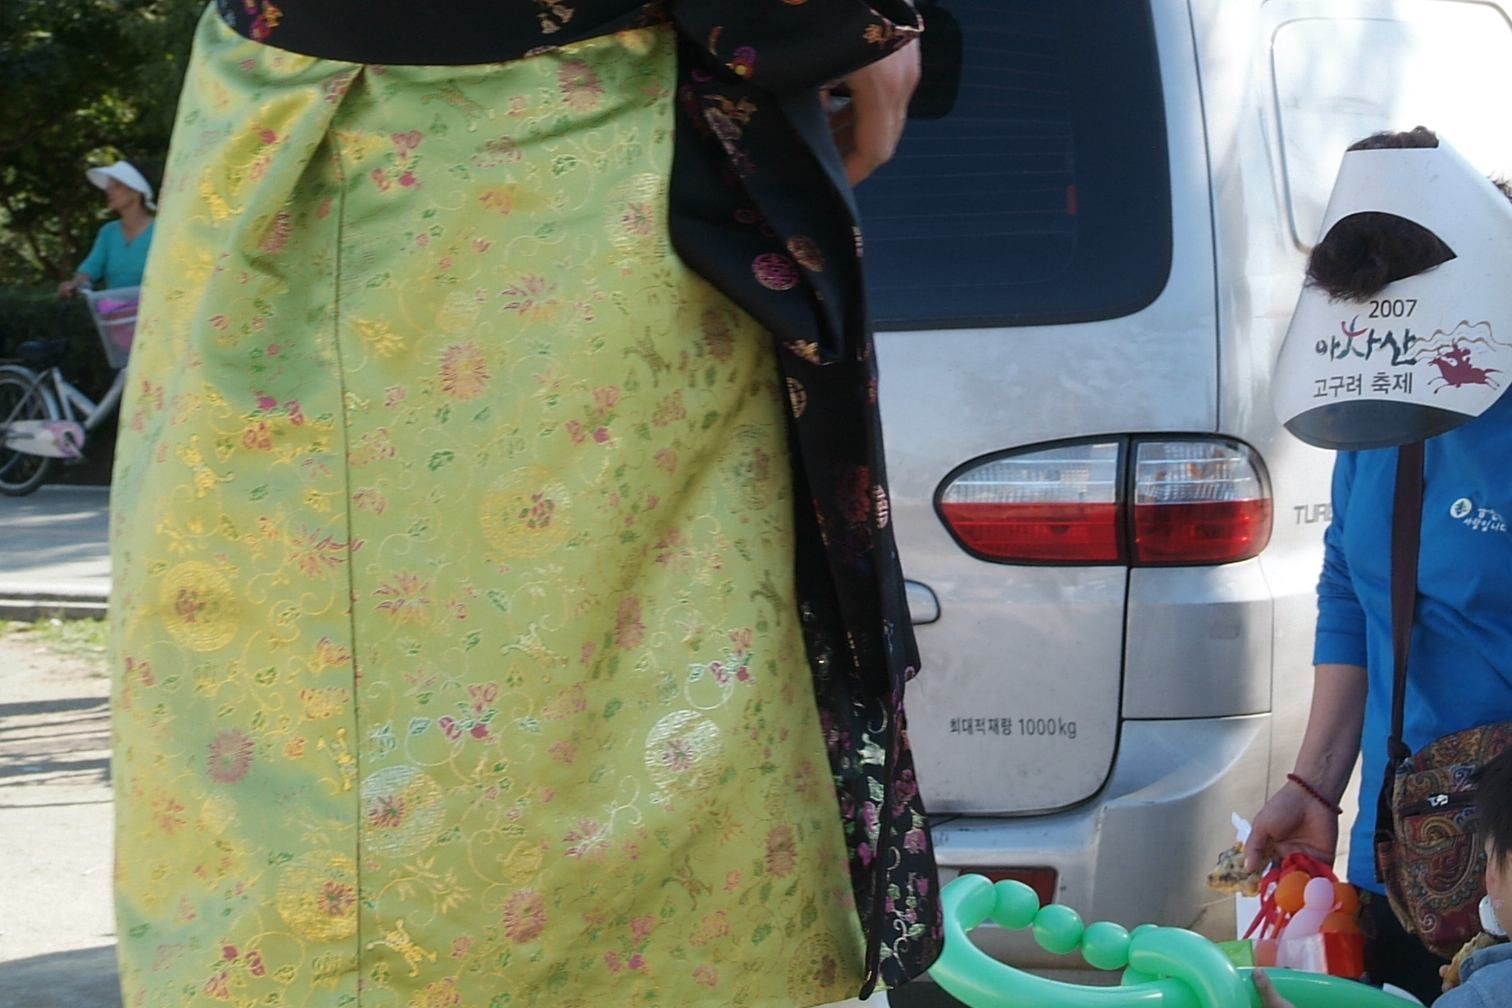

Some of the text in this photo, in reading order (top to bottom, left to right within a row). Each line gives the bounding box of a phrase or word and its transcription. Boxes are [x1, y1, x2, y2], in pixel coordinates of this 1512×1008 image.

[1368, 299, 1418, 319] 2007
[1313, 371, 1413, 398] 고구려 축제
[950, 717, 1077, 739] 최대적재량 1000kg
